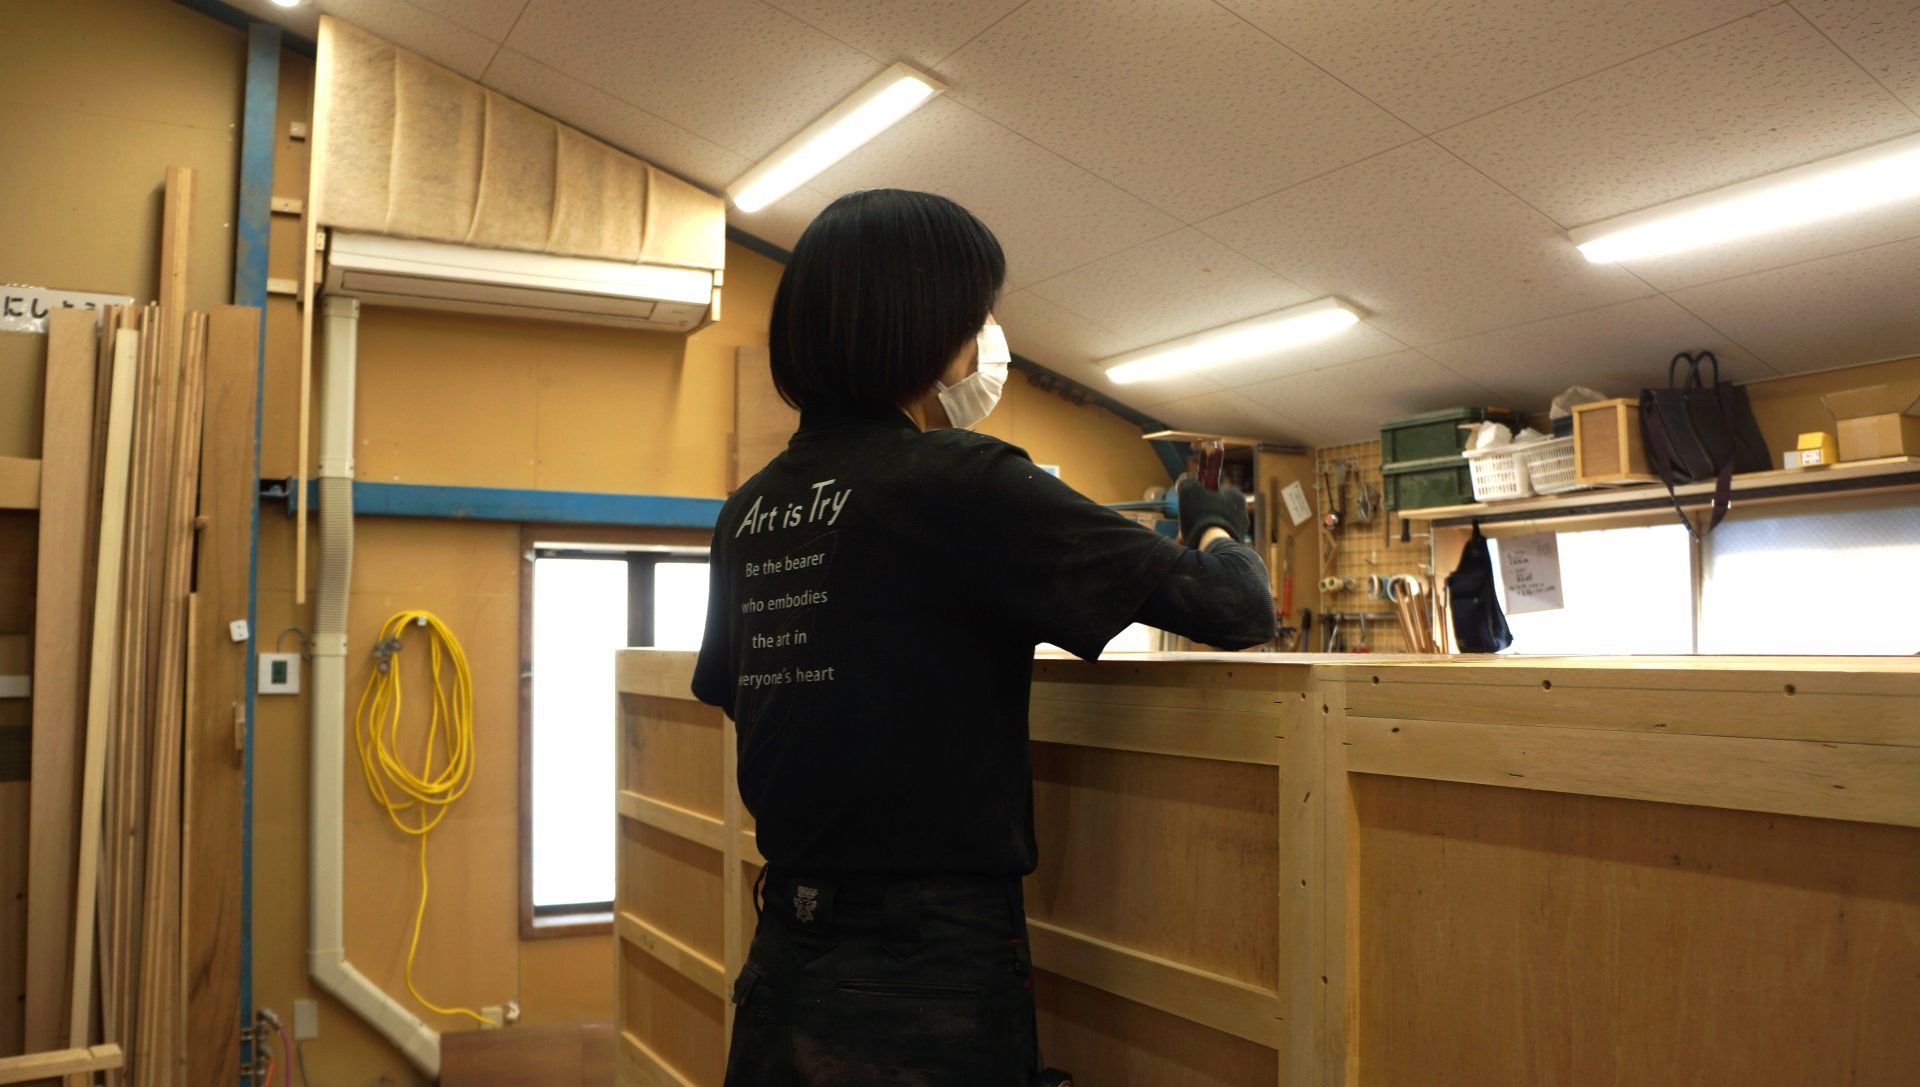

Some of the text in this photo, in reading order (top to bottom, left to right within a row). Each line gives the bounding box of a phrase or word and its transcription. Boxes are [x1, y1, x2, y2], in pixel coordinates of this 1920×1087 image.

[735, 479, 853, 538] Art is Try
[745, 553, 825, 578] Be the bearer
[741, 589, 828, 614] who embodies
[752, 629, 808, 649] the art in
[796, 666, 835, 682] heart
